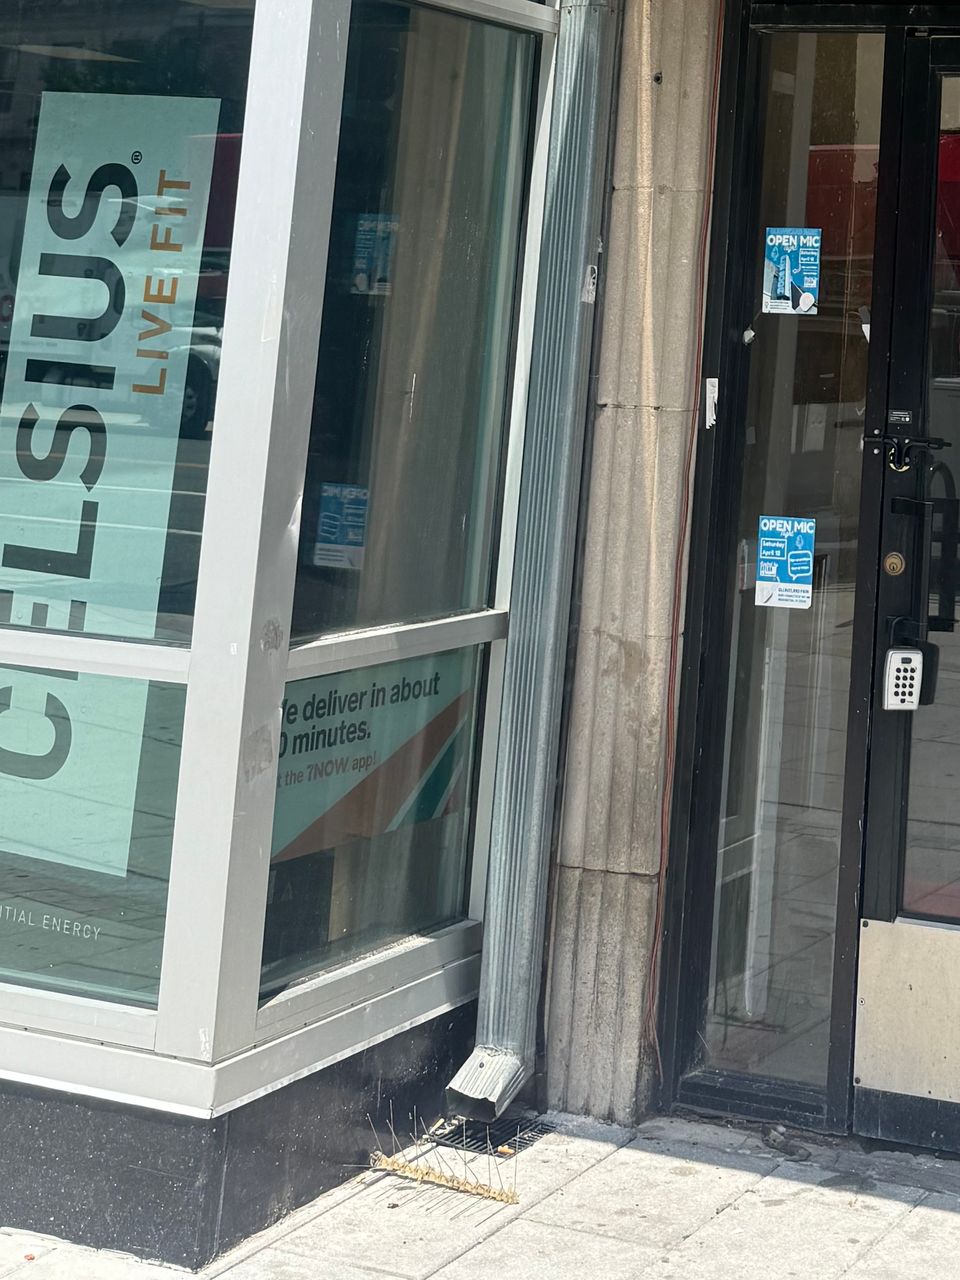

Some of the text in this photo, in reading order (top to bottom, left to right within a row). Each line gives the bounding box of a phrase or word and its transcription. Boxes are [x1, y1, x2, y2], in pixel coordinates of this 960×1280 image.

[767, 234, 820, 248] OPEN MIC
[132, 169, 193, 397] LIVE FIT
[760, 518, 815, 534] OPEN MIC
[302, 689, 368, 722] deliver
[370, 682, 386, 708] in
[390, 671, 441, 705] about
[291, 720, 372, 755] minutes.
[285, 771, 304, 785] the
[306, 756, 349, 782] 7NOW
[351, 750, 377, 773] app!
[42, 914, 101, 940] ENERGY
